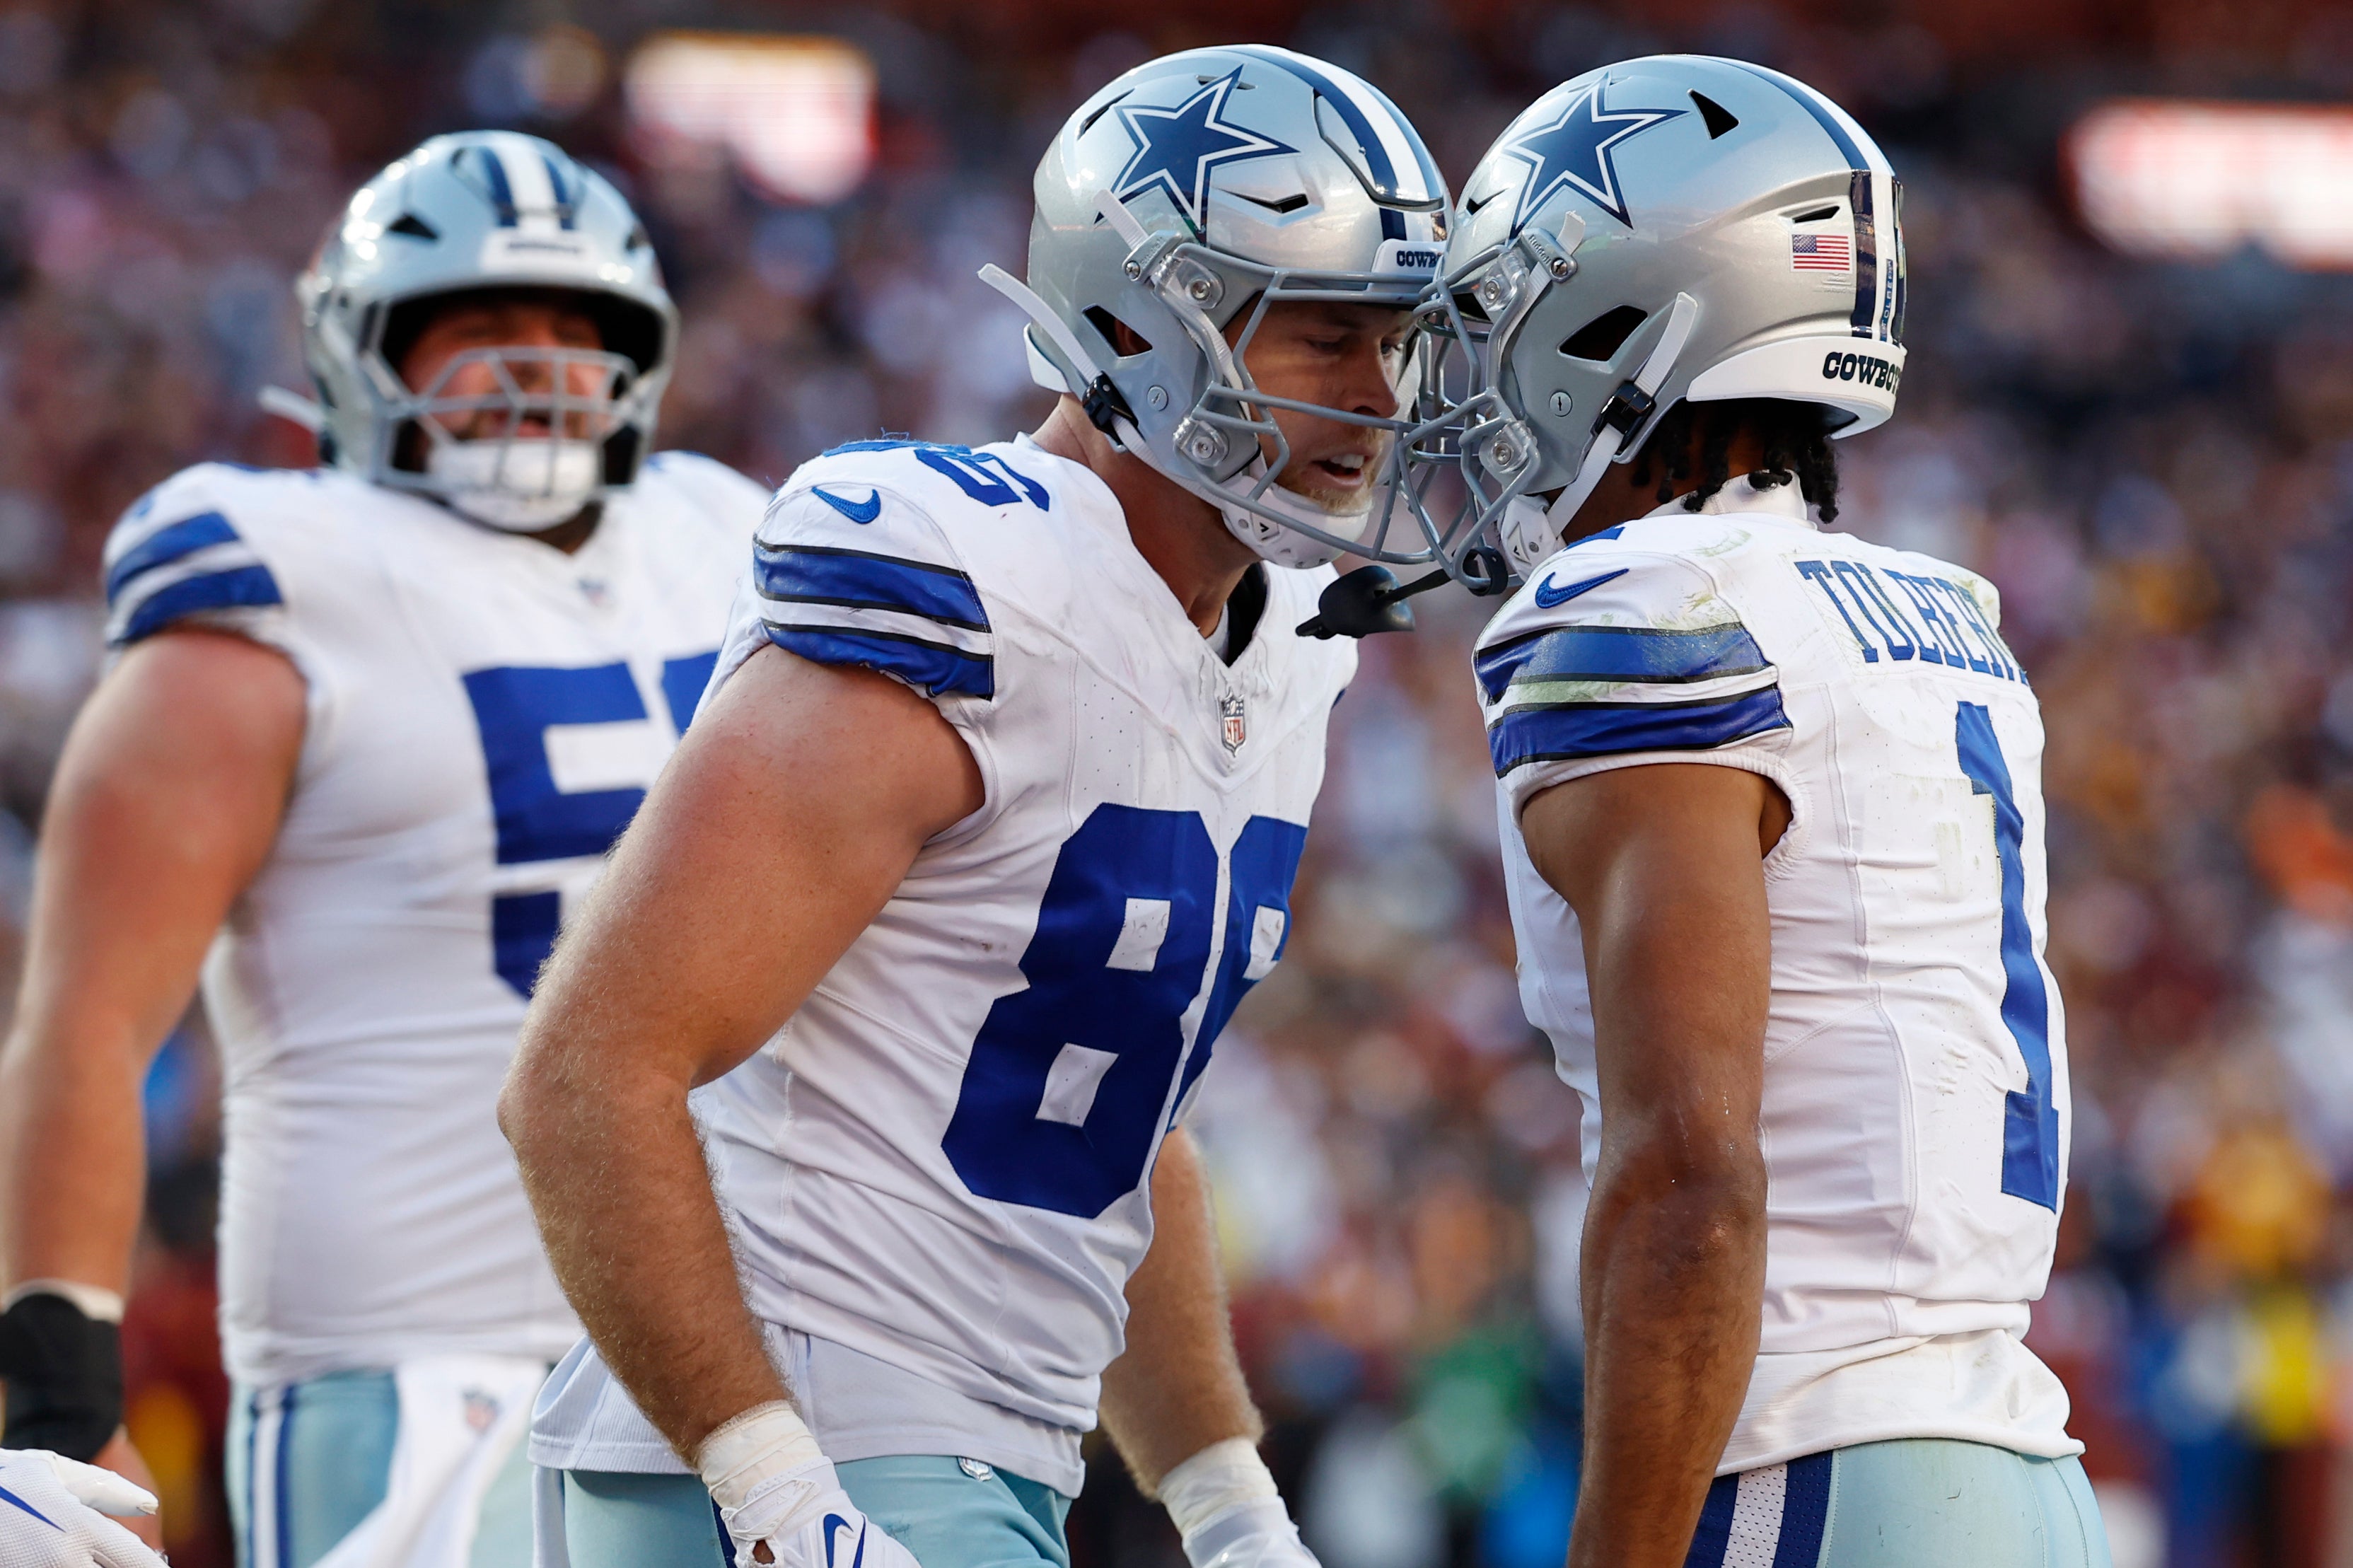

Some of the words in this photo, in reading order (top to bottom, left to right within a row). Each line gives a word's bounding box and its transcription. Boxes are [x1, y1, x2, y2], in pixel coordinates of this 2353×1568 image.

[1396, 250, 1441, 267] COWB
[462, 649, 719, 1002] 5
[1955, 700, 2059, 1214] 1
